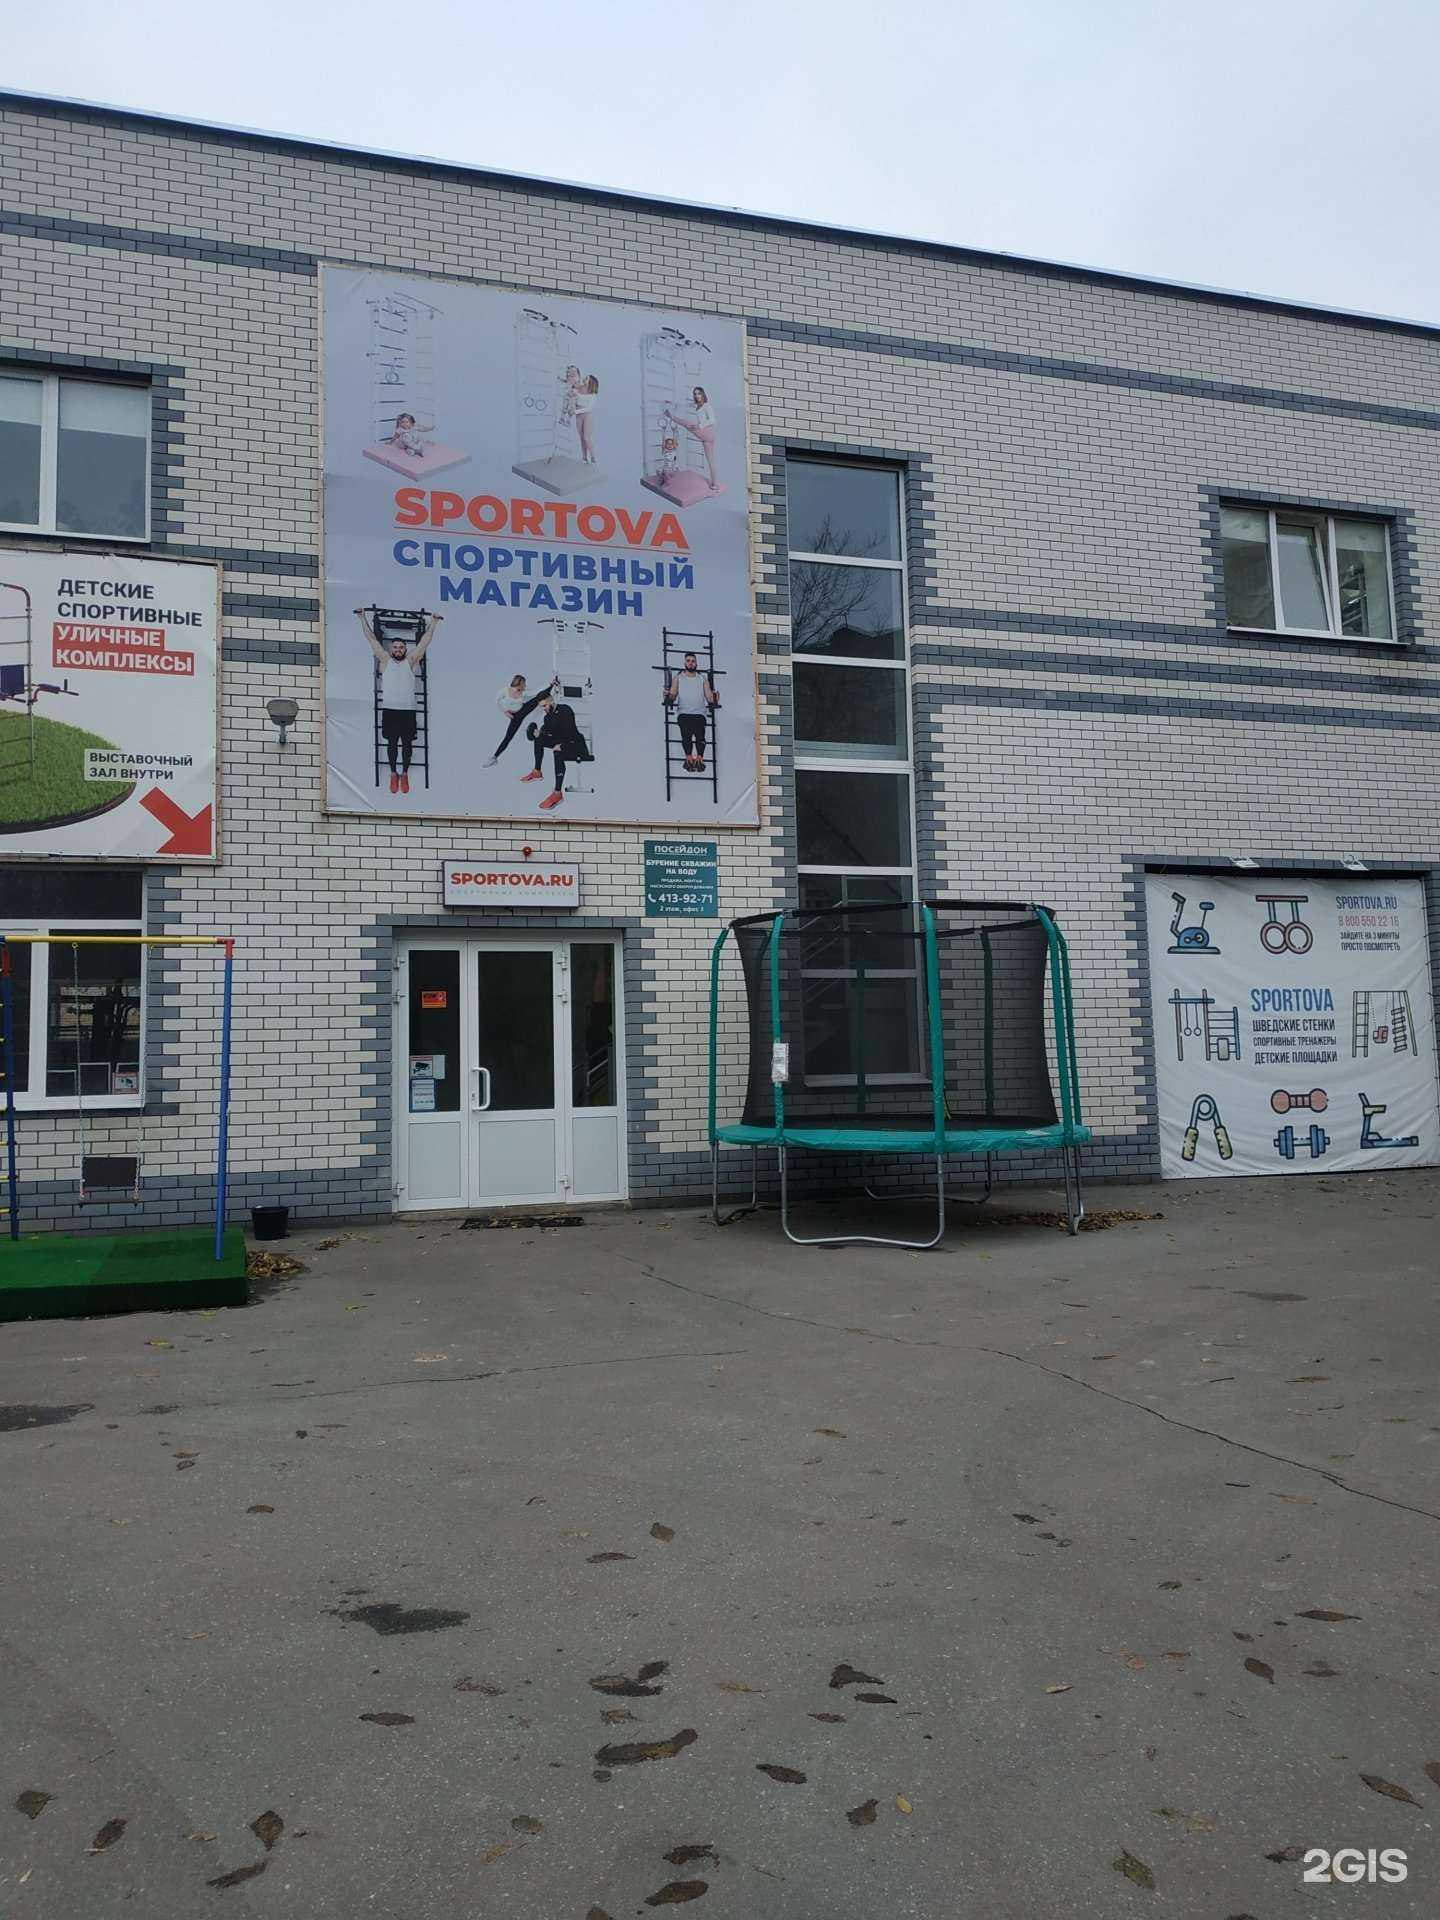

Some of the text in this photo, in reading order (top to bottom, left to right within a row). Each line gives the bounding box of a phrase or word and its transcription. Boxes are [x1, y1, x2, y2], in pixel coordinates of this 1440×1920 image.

[394, 487, 690, 549] SPORTOVA
[392, 539, 695, 589] СПОРТИВНЫЙ
[57, 578, 155, 600] ДЕТСКИЕ
[439, 575, 643, 617] МАГАЗИН
[57, 602, 203, 627] СПОРТИВНЫЕ
[56, 624, 162, 647] УЛИЧНЫЕ
[55, 648, 193, 673] КОМПЛЕКСЫ
[89, 752, 193, 767] ВЫСТАВОЧНЫЙ
[89, 767, 174, 780] ЗАЛ ВНУТРИ
[654, 844, 708, 855] ПОСЕЙДОН
[645, 859, 717, 868] БУРЕНИЕ СКВАЖИН
[450, 872, 574, 887] SPORTOVA.RU
[678, 868, 698, 876] ВОДУ
[658, 893, 713, 904] 413-92-71
[1335, 895, 1398, 910] SPORTOVA.RU
[1338, 916, 1344, 927] 8
[1345, 915, 1360, 927] 800
[1361, 915, 1376, 928] 550
[1341, 942, 1400, 951] ПРОСТО ПОСМОТРЕТЬ
[1250, 988, 1334, 1012] SPORTOVA
[1252, 1018, 1336, 1033] ШВЕДСКИЕ СТЕНКИ
[1253, 1036, 1337, 1046] СПОРТИВНЫЕ ТРЕНАЖЕРЫ
[1254, 1050, 1338, 1065] ДЕТСКИЕ ПЛОЩАДКИ
